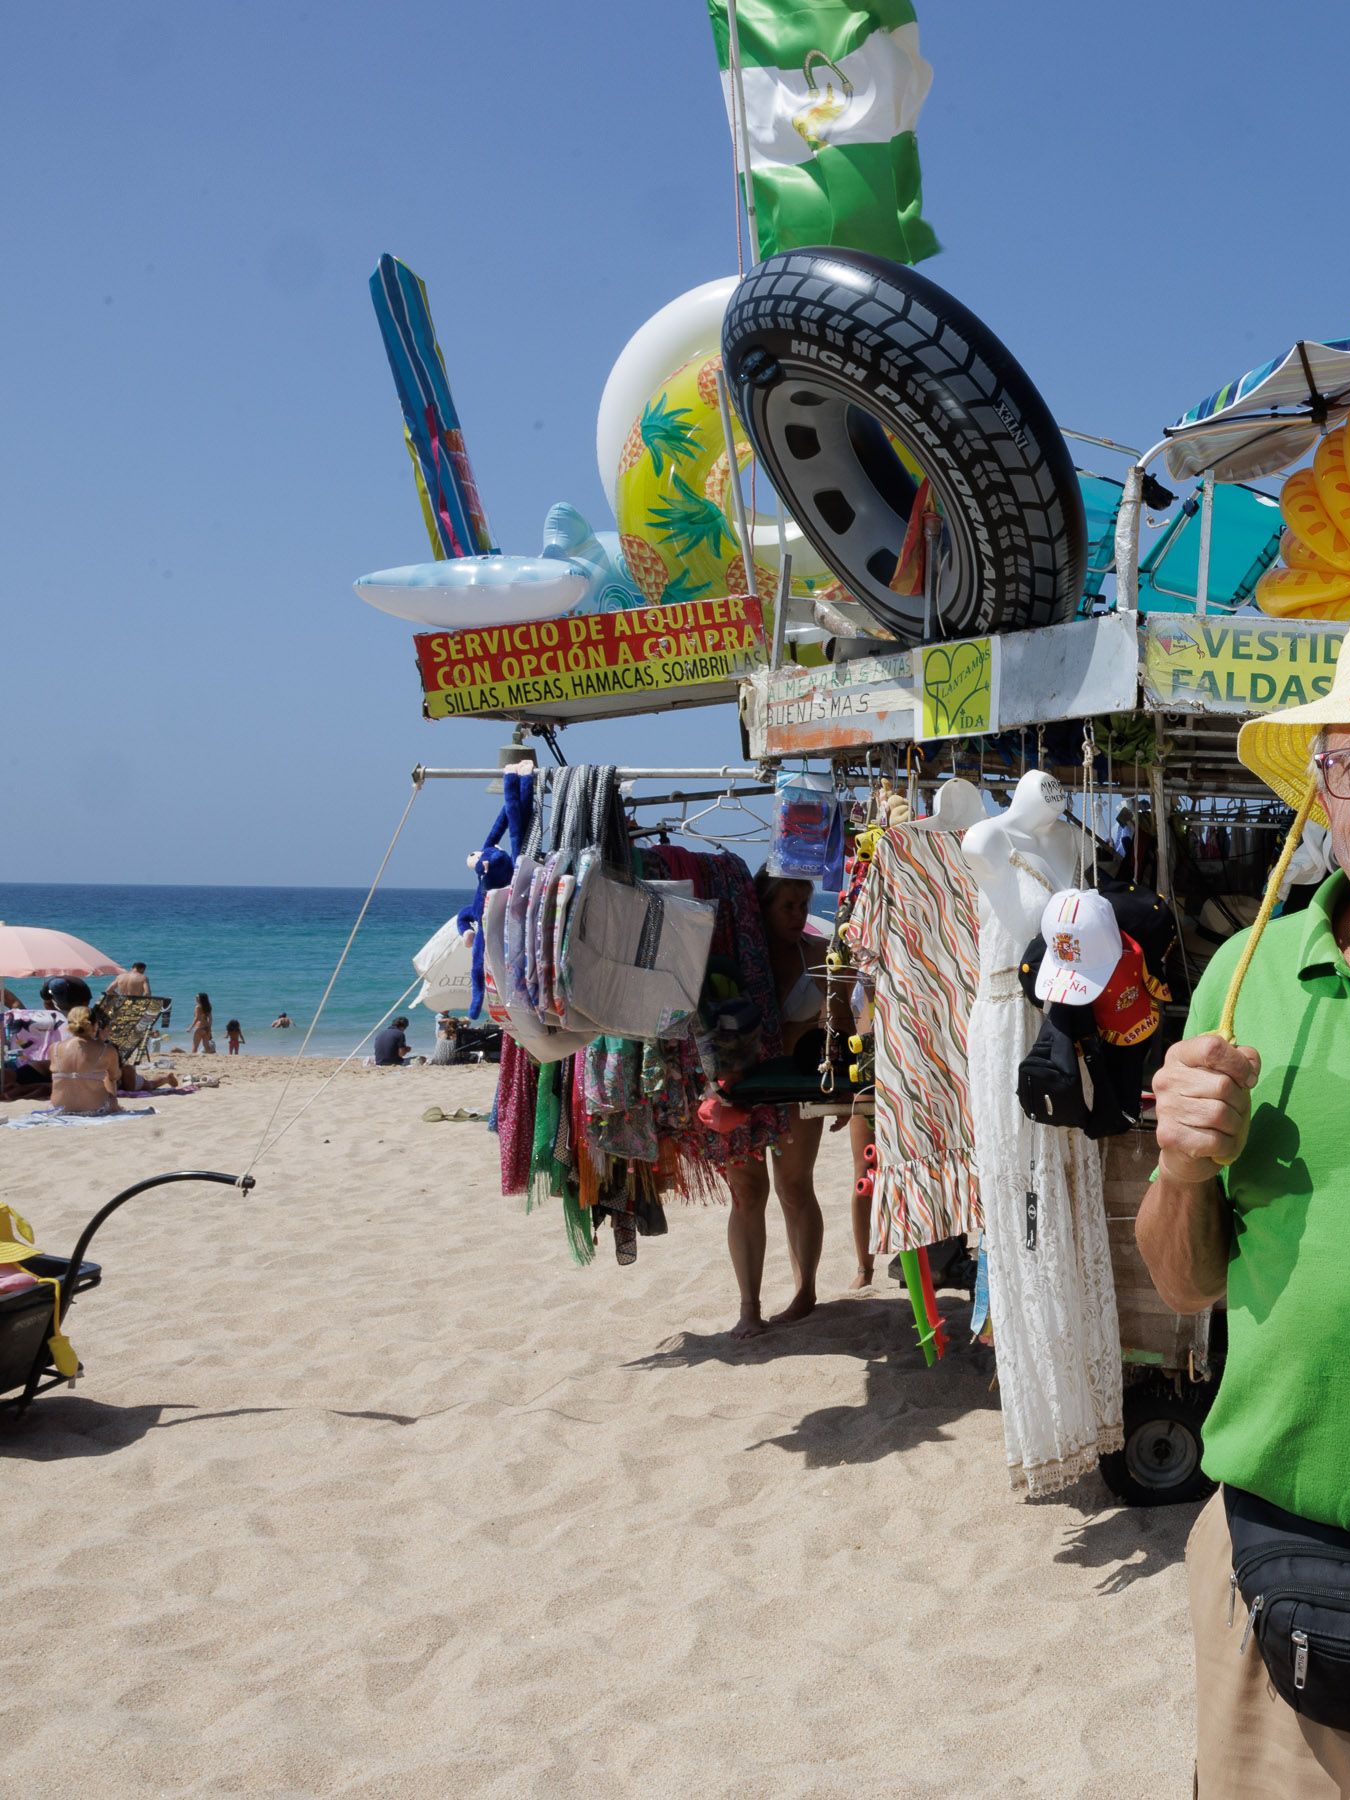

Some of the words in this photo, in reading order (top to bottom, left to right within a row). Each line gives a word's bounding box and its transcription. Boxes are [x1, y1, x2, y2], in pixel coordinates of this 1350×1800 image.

[997, 403, 1029, 451] INTEX
[791, 338, 868, 383] HIGH
[873, 381, 994, 635] PERFORMANCE
[431, 623, 559, 662] SERVICIO
[568, 616, 603, 643] DE
[614, 599, 747, 637] ALQUILER
[436, 660, 493, 690] CON
[502, 642, 607, 681] OPCIÓN
[618, 644, 633, 665] A
[643, 624, 756, 660] COMPRA
[445, 687, 506, 714] SILLAS,
[508, 675, 569, 705] MESAS,
[571, 665, 659, 697] HAMACAS,
[663, 650, 761, 683] SOMBRILLAS
[1124, 1015, 1158, 1044] ESPAÑA
